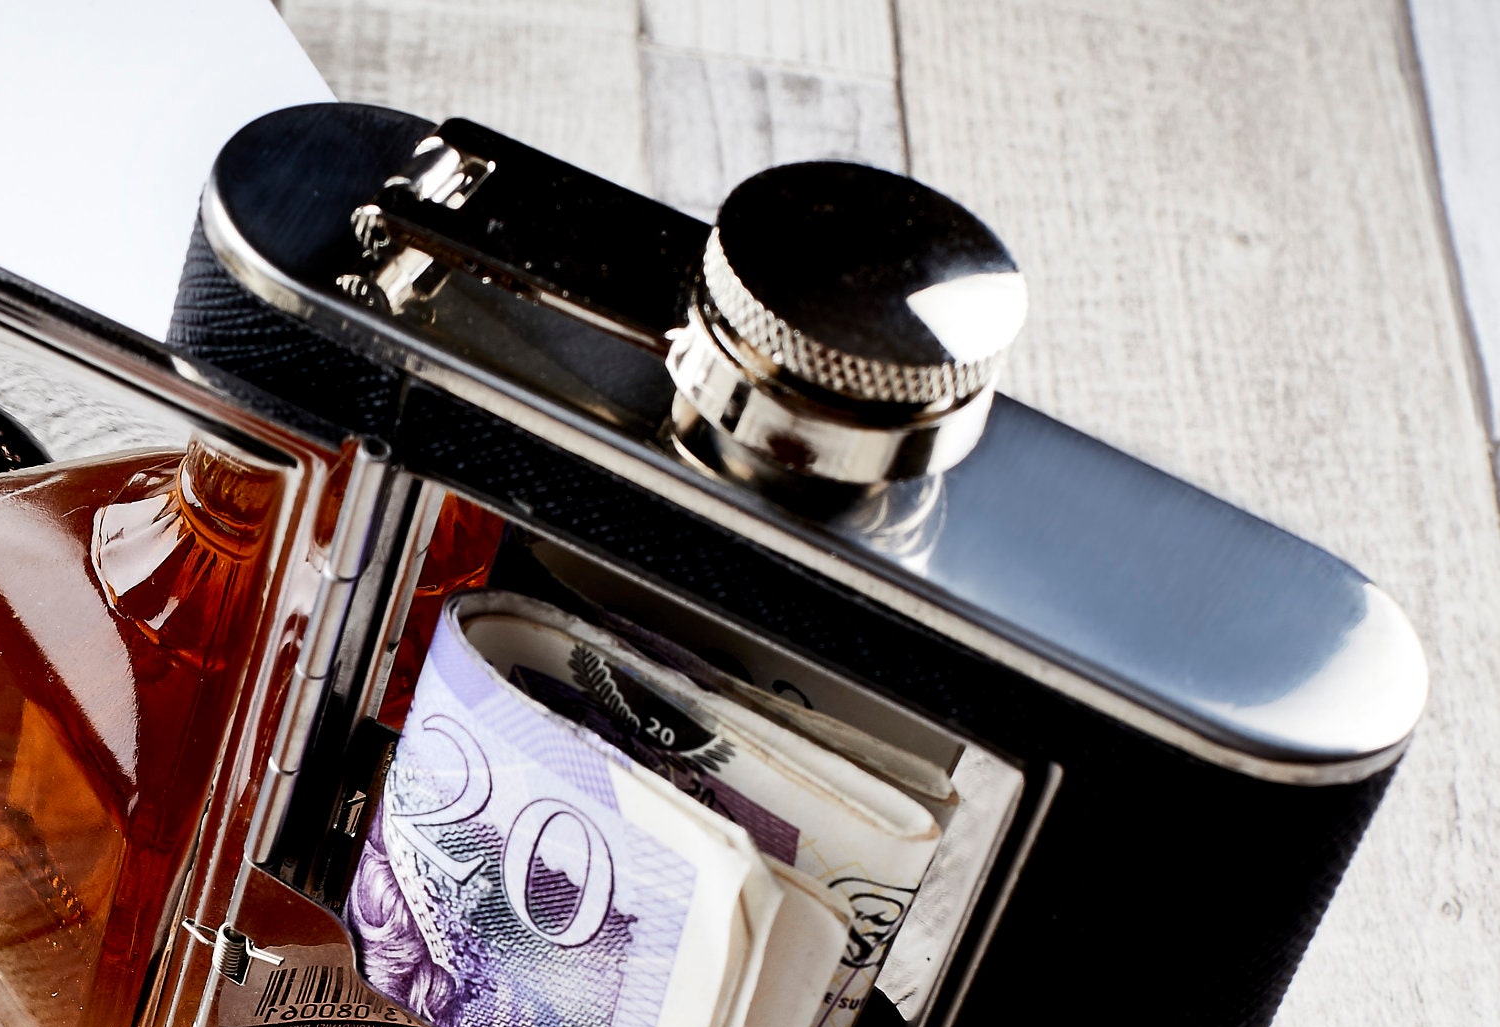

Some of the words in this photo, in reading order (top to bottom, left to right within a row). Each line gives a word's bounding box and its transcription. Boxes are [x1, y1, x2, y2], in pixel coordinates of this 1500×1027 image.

[645, 716, 676, 746] 20
[390, 714, 615, 948] 20
[837, 997, 866, 1011] SU
